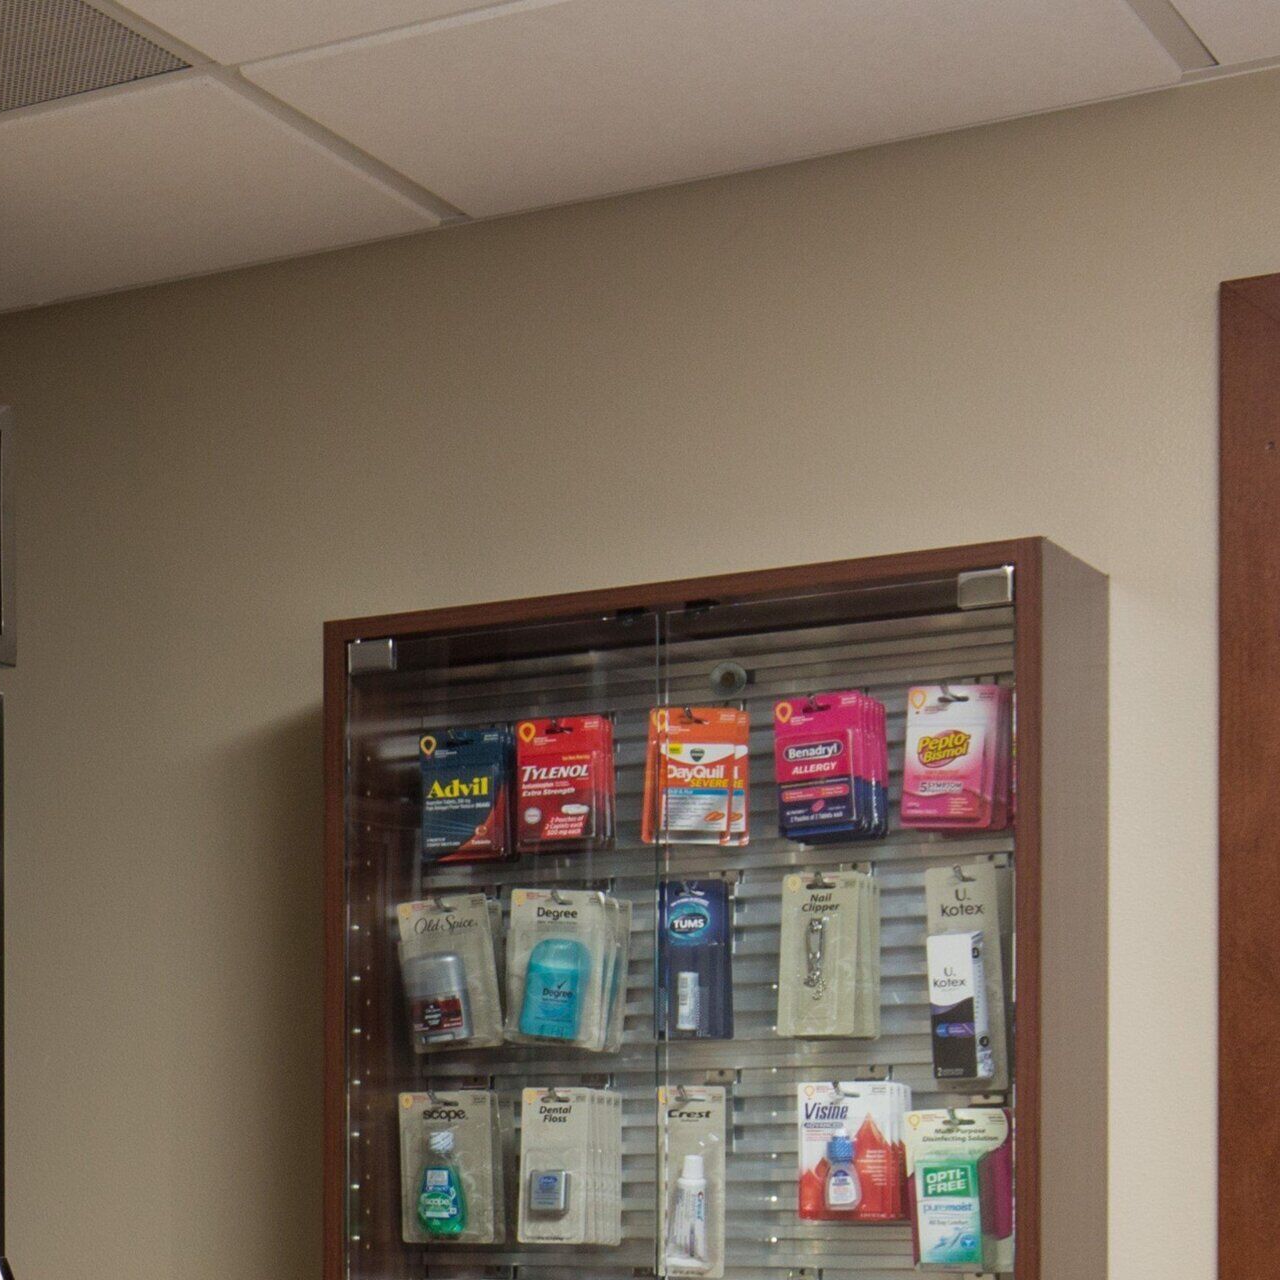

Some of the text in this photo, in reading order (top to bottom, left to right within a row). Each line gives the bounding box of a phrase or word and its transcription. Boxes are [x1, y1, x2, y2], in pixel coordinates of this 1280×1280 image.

[788, 743, 838, 760] Benadryl
[924, 744, 969, 764] Bismol
[522, 764, 589, 782] TYLENOL
[667, 765, 725, 782] DayQuil
[792, 762, 837, 775] ALLERGY
[427, 776, 488, 798] Advil
[690, 779, 729, 788] SEVERE
[920, 782, 928, 792] 5
[543, 787, 575, 795] Strength
[810, 893, 832, 902] Nail
[537, 907, 578, 920] Degree
[801, 903, 840, 914] Clipper
[414, 915, 474, 934] Old Spice
[672, 919, 704, 929] TUMS
[543, 988, 573, 999] Degree
[423, 1109, 466, 1122] scope
[539, 1106, 572, 1115] Dental
[668, 1109, 711, 1119] Crest
[804, 1101, 848, 1120] Visine
[543, 1115, 568, 1124] Floss
[926, 1169, 965, 1184] OPTI-
[927, 1179, 966, 1195] FREE
